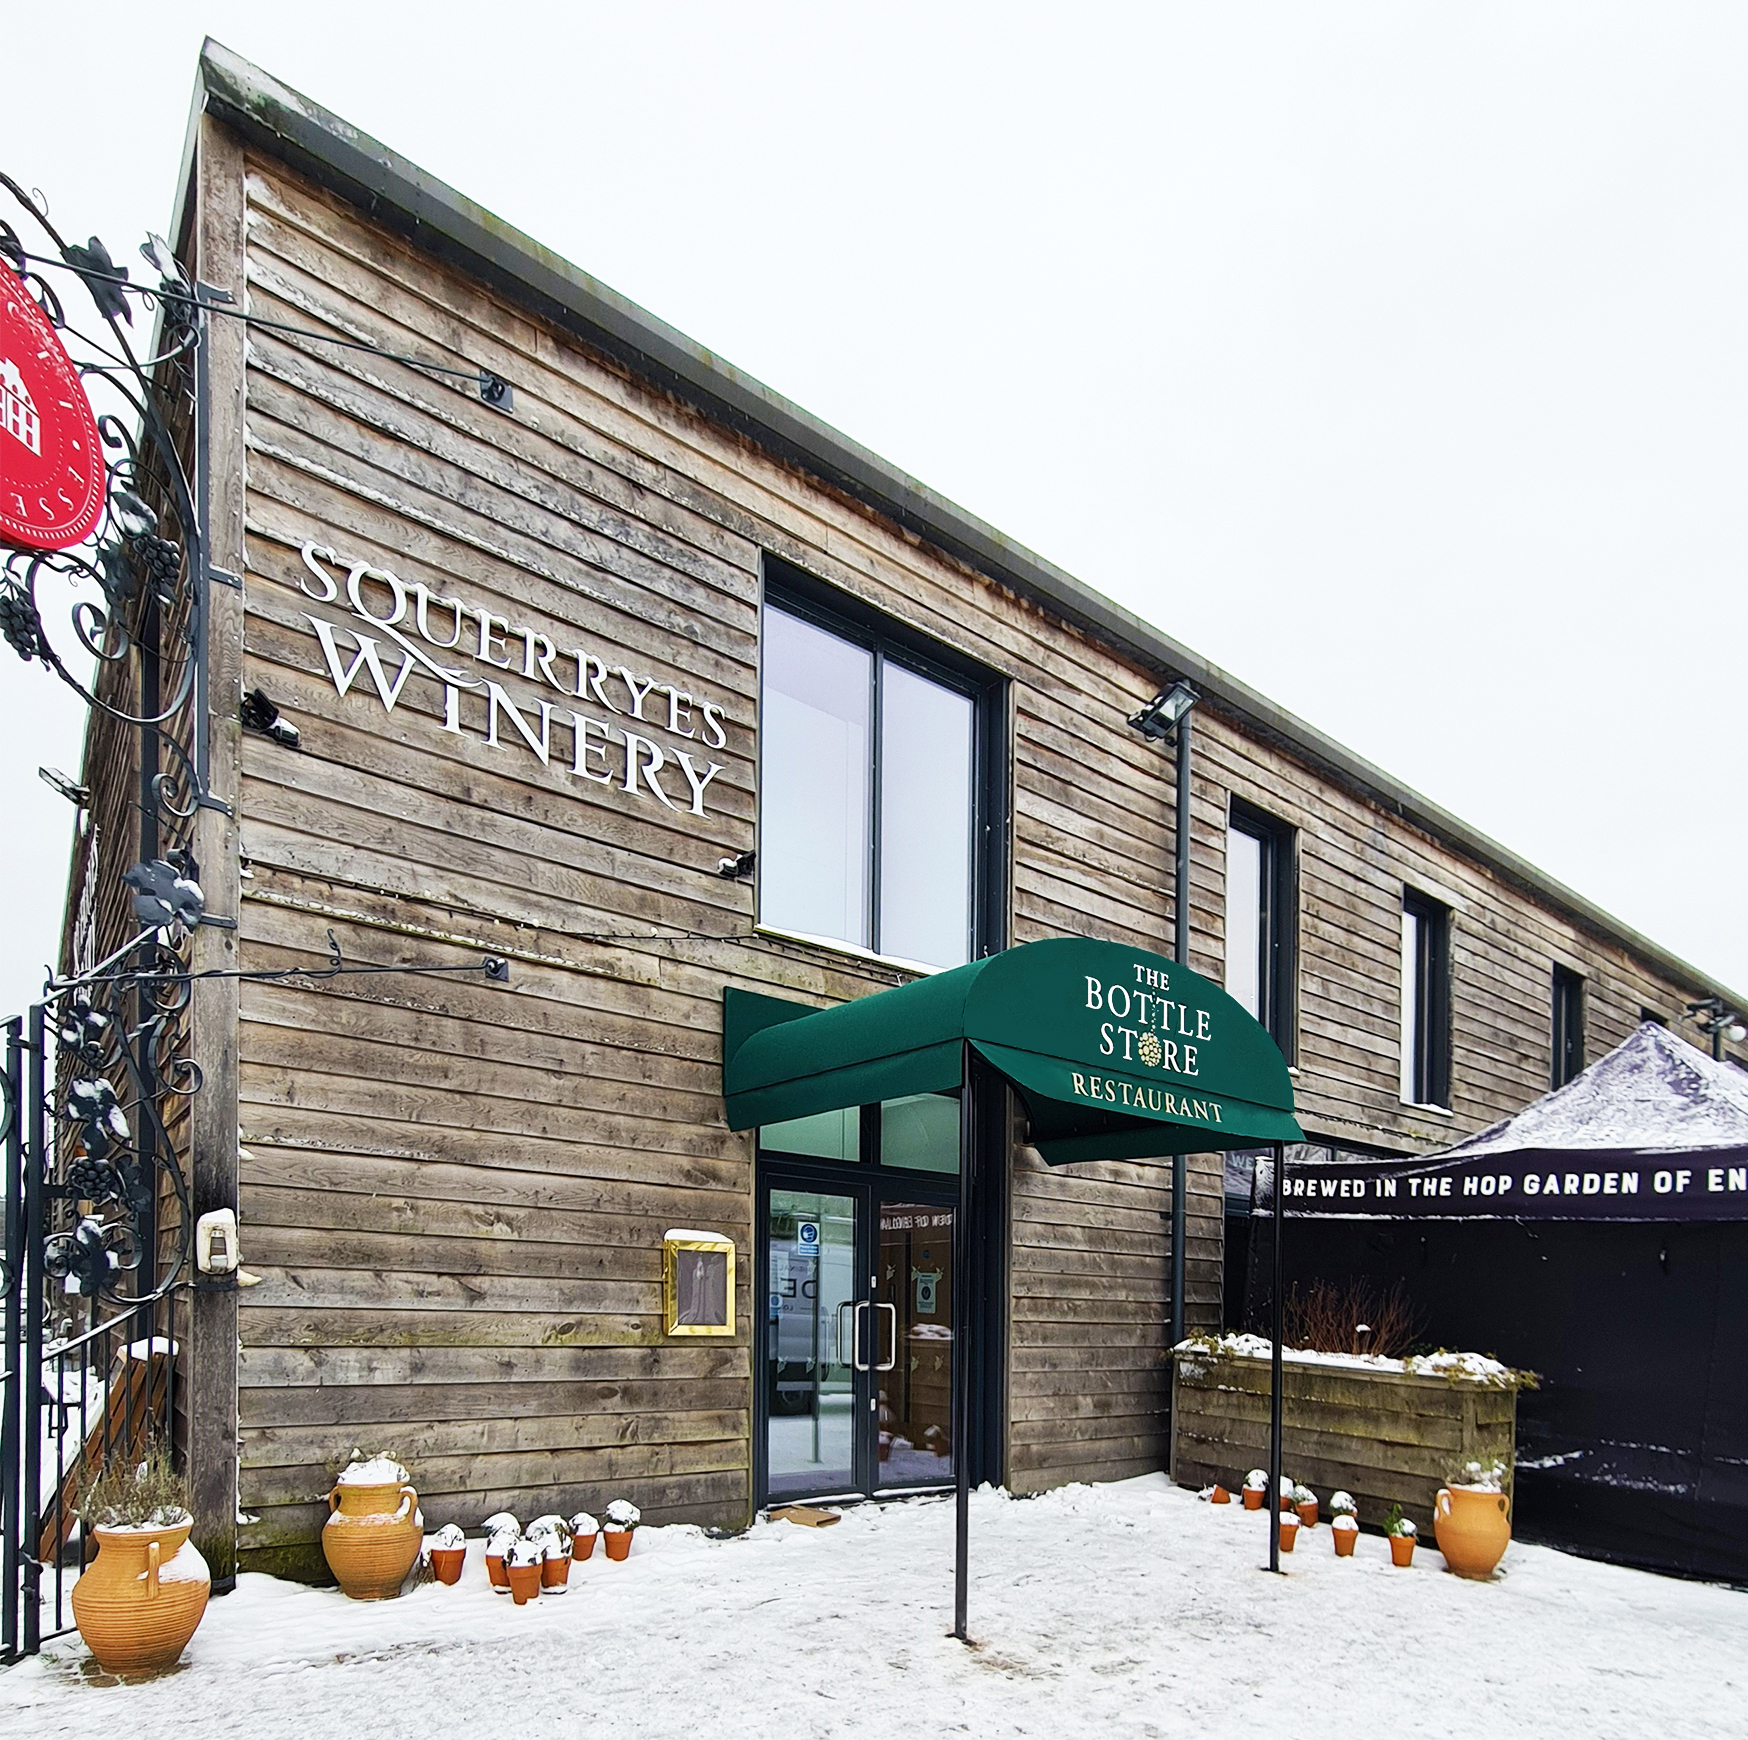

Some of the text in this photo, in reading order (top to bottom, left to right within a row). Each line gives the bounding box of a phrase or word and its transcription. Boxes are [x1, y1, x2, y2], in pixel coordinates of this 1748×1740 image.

[299, 541, 728, 750] SQUERRYES
[299, 611, 726, 820] WINERY
[1132, 963, 1170, 991] THE
[1084, 975, 1212, 1041] BOTTLE
[1099, 1022, 1200, 1076] STORE
[1071, 1072, 1223, 1123] RESTAURANT
[1282, 1167, 1748, 1199] BREWED IN THE HOP GARDEN OF EN
